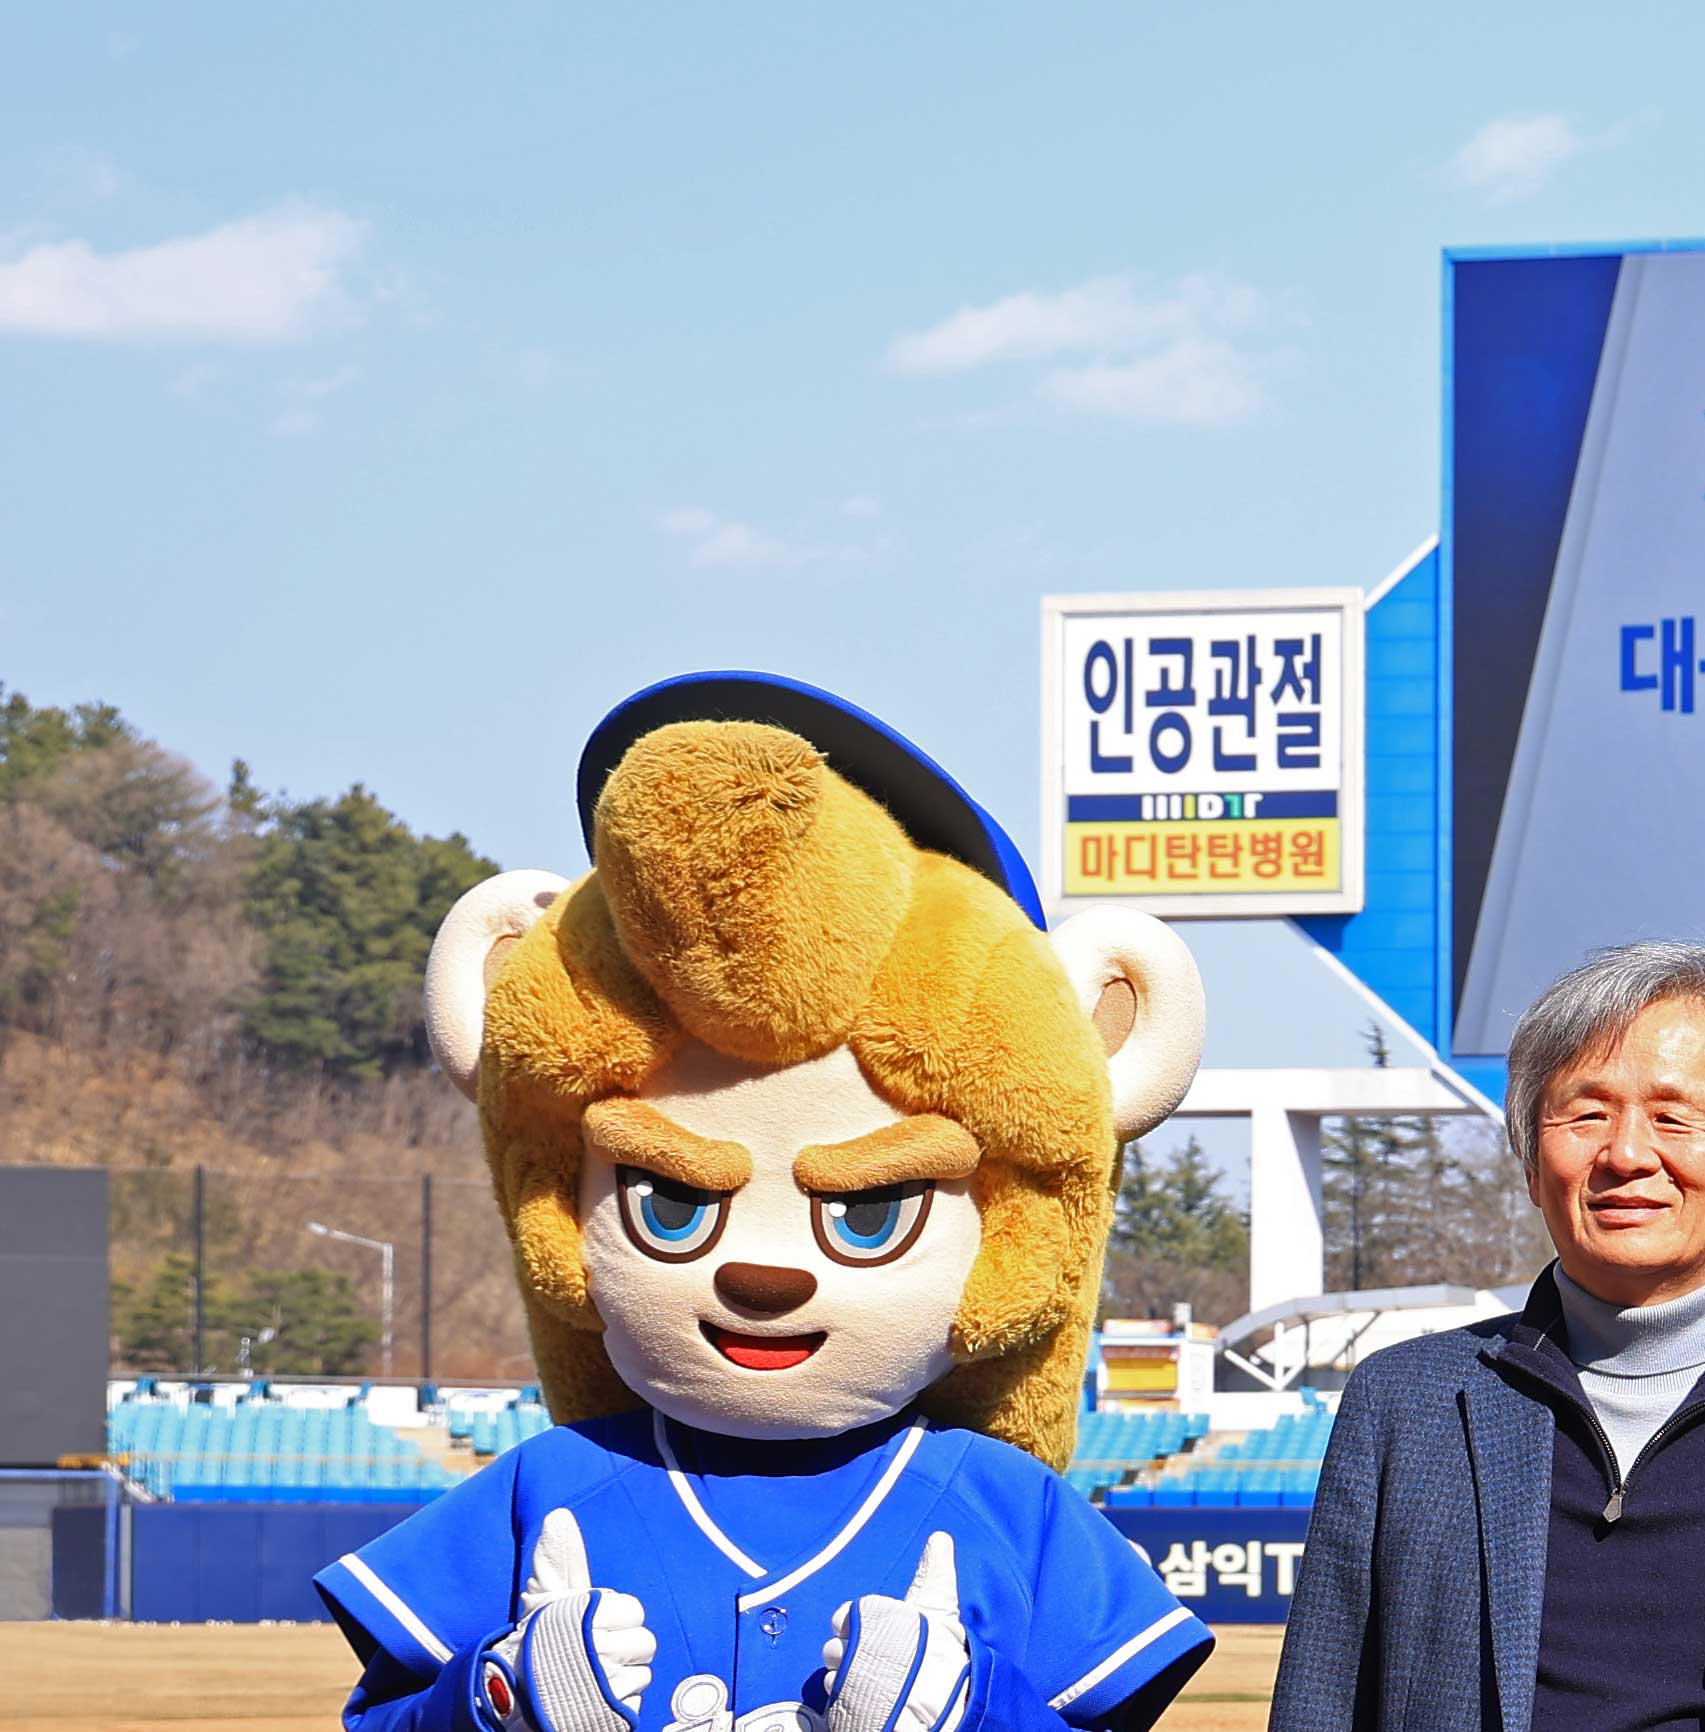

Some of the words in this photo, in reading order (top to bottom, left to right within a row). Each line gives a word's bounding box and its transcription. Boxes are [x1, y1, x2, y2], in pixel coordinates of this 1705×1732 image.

[1084, 633, 1322, 774] 인공관절
[1080, 830, 1325, 881] 마디탄탄병원
[1159, 1541, 1304, 1597] 삼익T
